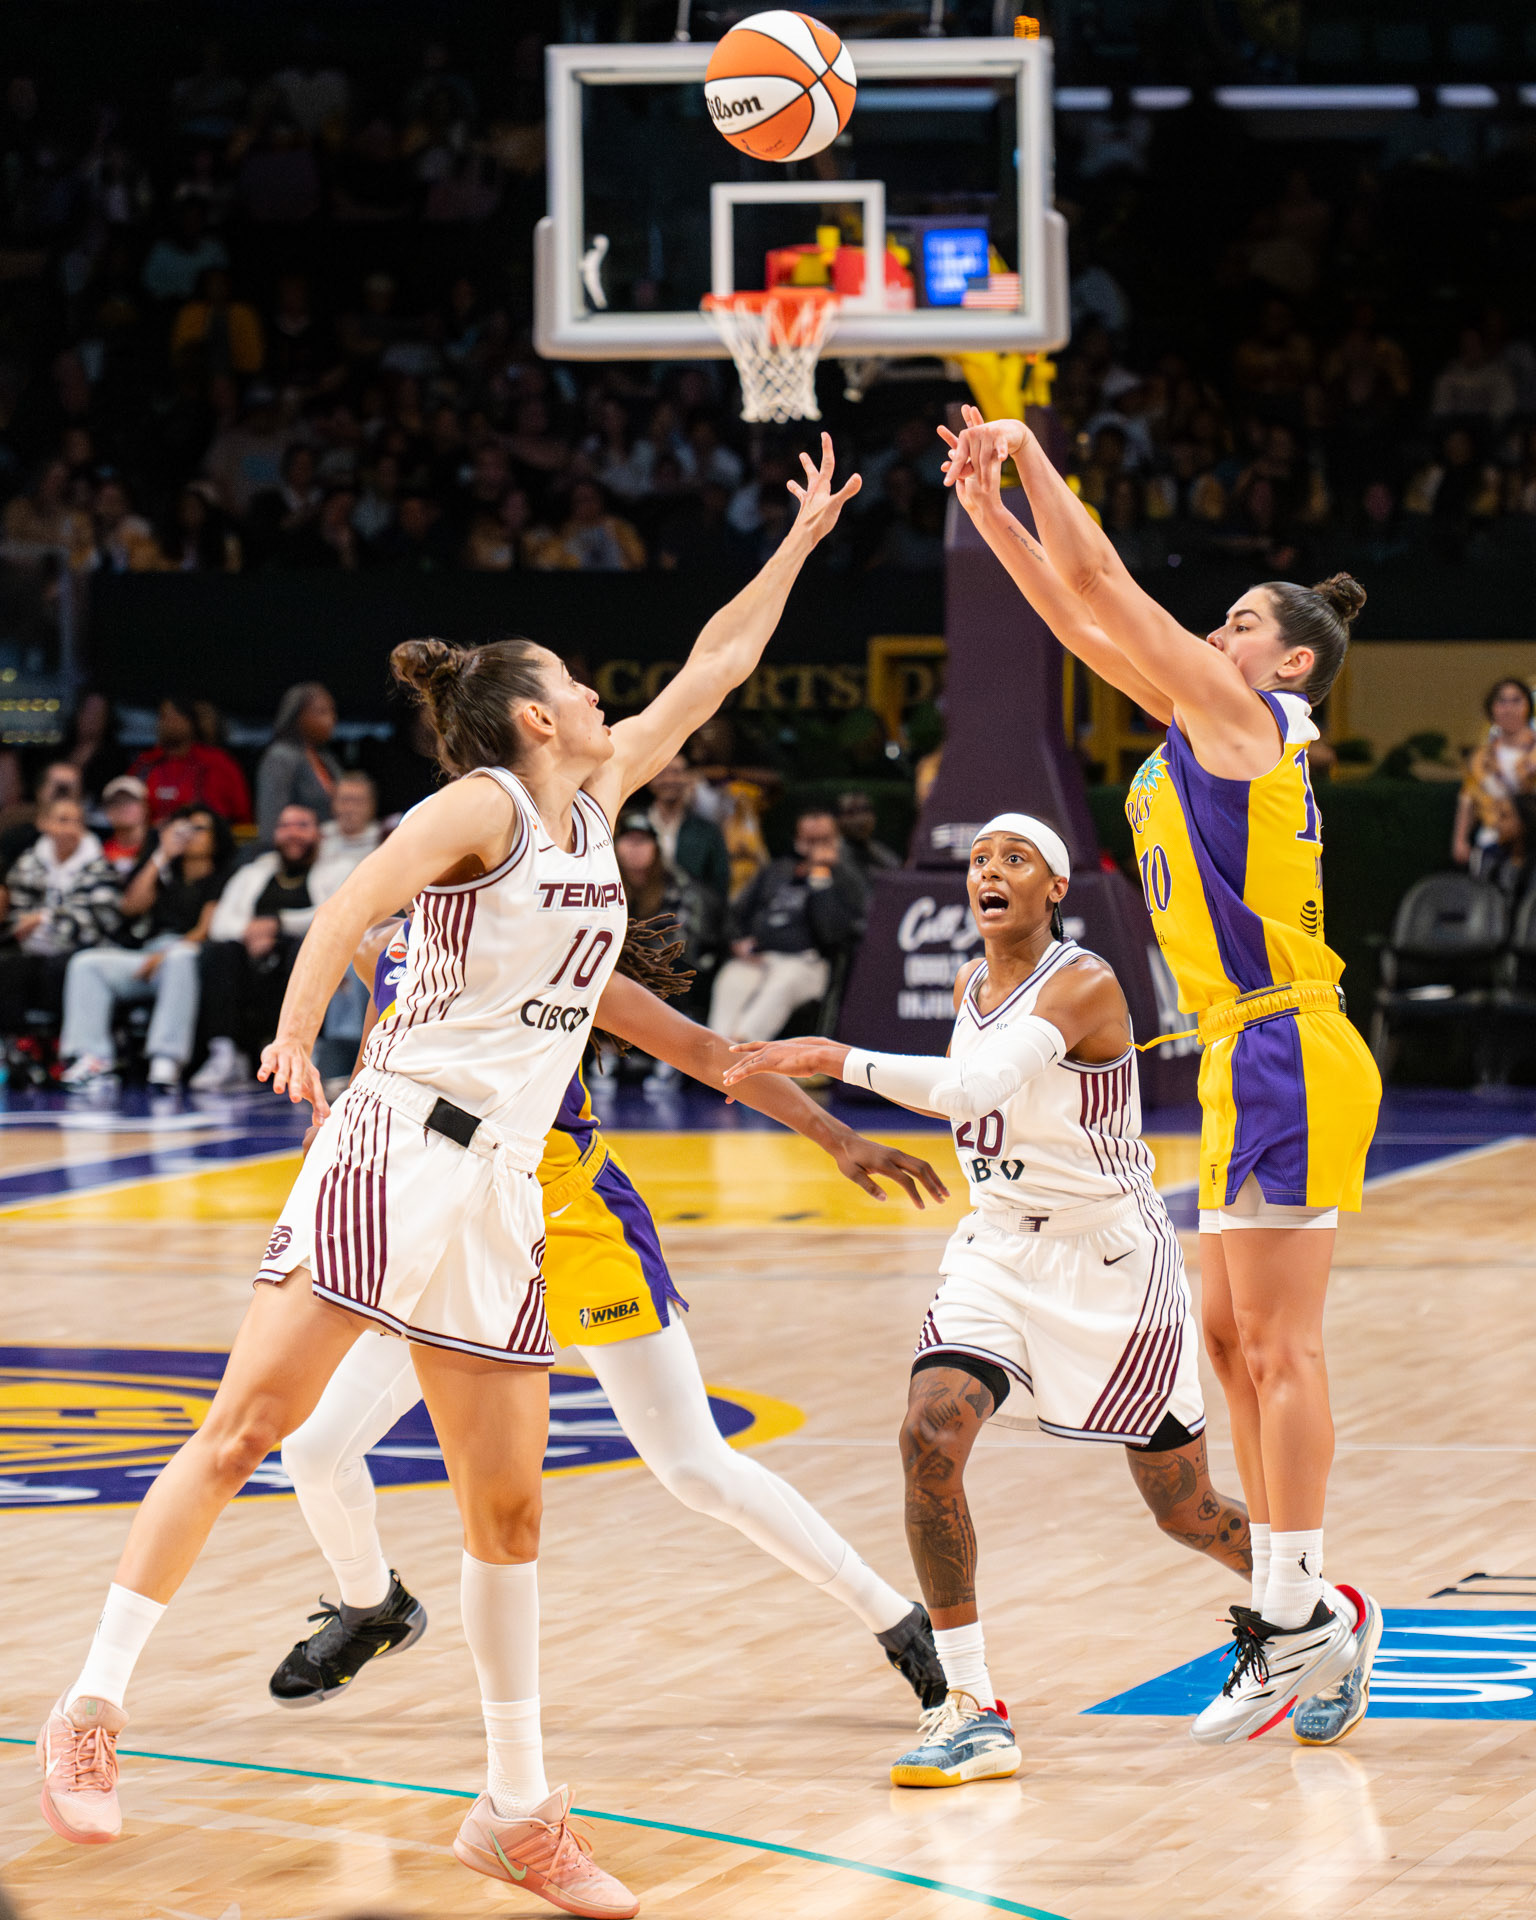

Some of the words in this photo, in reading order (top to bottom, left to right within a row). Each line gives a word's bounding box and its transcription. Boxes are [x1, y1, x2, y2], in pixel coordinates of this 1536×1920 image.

[1139, 843, 1172, 915] 10
[546, 927, 614, 989] 10
[520, 999, 577, 1032] CIBC
[955, 1109, 1007, 1158] 20
[592, 1301, 640, 1323] WNBA
